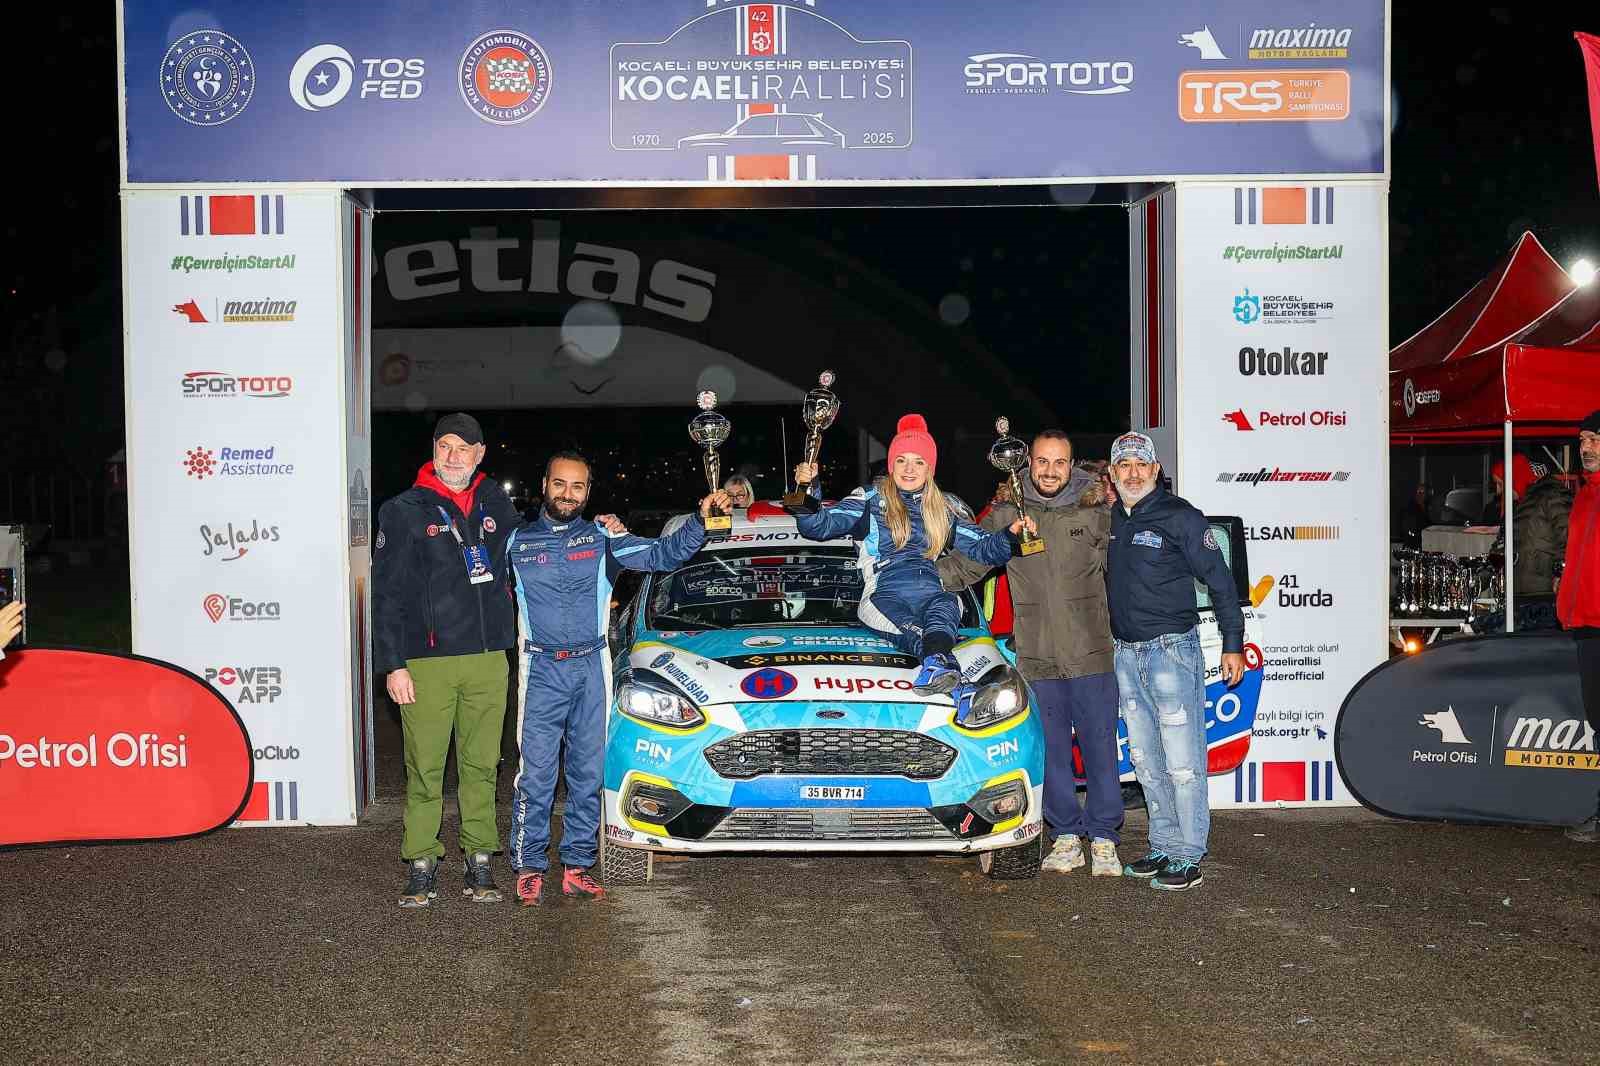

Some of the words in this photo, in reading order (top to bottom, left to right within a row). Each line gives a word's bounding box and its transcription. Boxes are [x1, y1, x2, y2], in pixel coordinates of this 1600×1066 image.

[1249, 23, 1352, 48] maxima
[361, 58, 425, 76] TOS
[360, 78, 423, 99] FED
[1185, 82, 1284, 114] TRS
[632, 135, 660, 146] 1970
[863, 133, 895, 144] 2025
[372, 219, 717, 322] etlas
[223, 297, 297, 314] maxima
[1239, 347, 1328, 376] Otokar
[1259, 411, 1306, 426] Petrol
[1309, 410, 1347, 426] Ofisi
[221, 447, 274, 461] Remed
[221, 463, 294, 476] Assistance
[200, 519, 281, 556] Salados
[1279, 575, 1300, 588] 41
[1278, 589, 1333, 608] burda
[229, 598, 280, 617] Fora
[1290, 643, 1315, 653] ortak
[774, 655, 874, 663] BINANCE
[880, 656, 907, 664] TR
[204, 667, 282, 685] POWER
[814, 676, 913, 693] Hypco
[238, 686, 282, 703] APP
[1279, 709, 1302, 723] bilgi
[1305, 710, 1325, 722] için
[1507, 717, 1596, 751] max
[0, 734, 97, 768] Petrol
[107, 733, 187, 768] Ofisi
[635, 738, 673, 763] PIN
[987, 736, 1019, 761] PIN
[1412, 750, 1447, 763] Petrol
[1450, 751, 1478, 764] Ofisi
[1520, 753, 1576, 767] MOTOR
[808, 788, 820, 798] 35
[822, 788, 842, 798] BVR
[845, 788, 863, 798] 714
